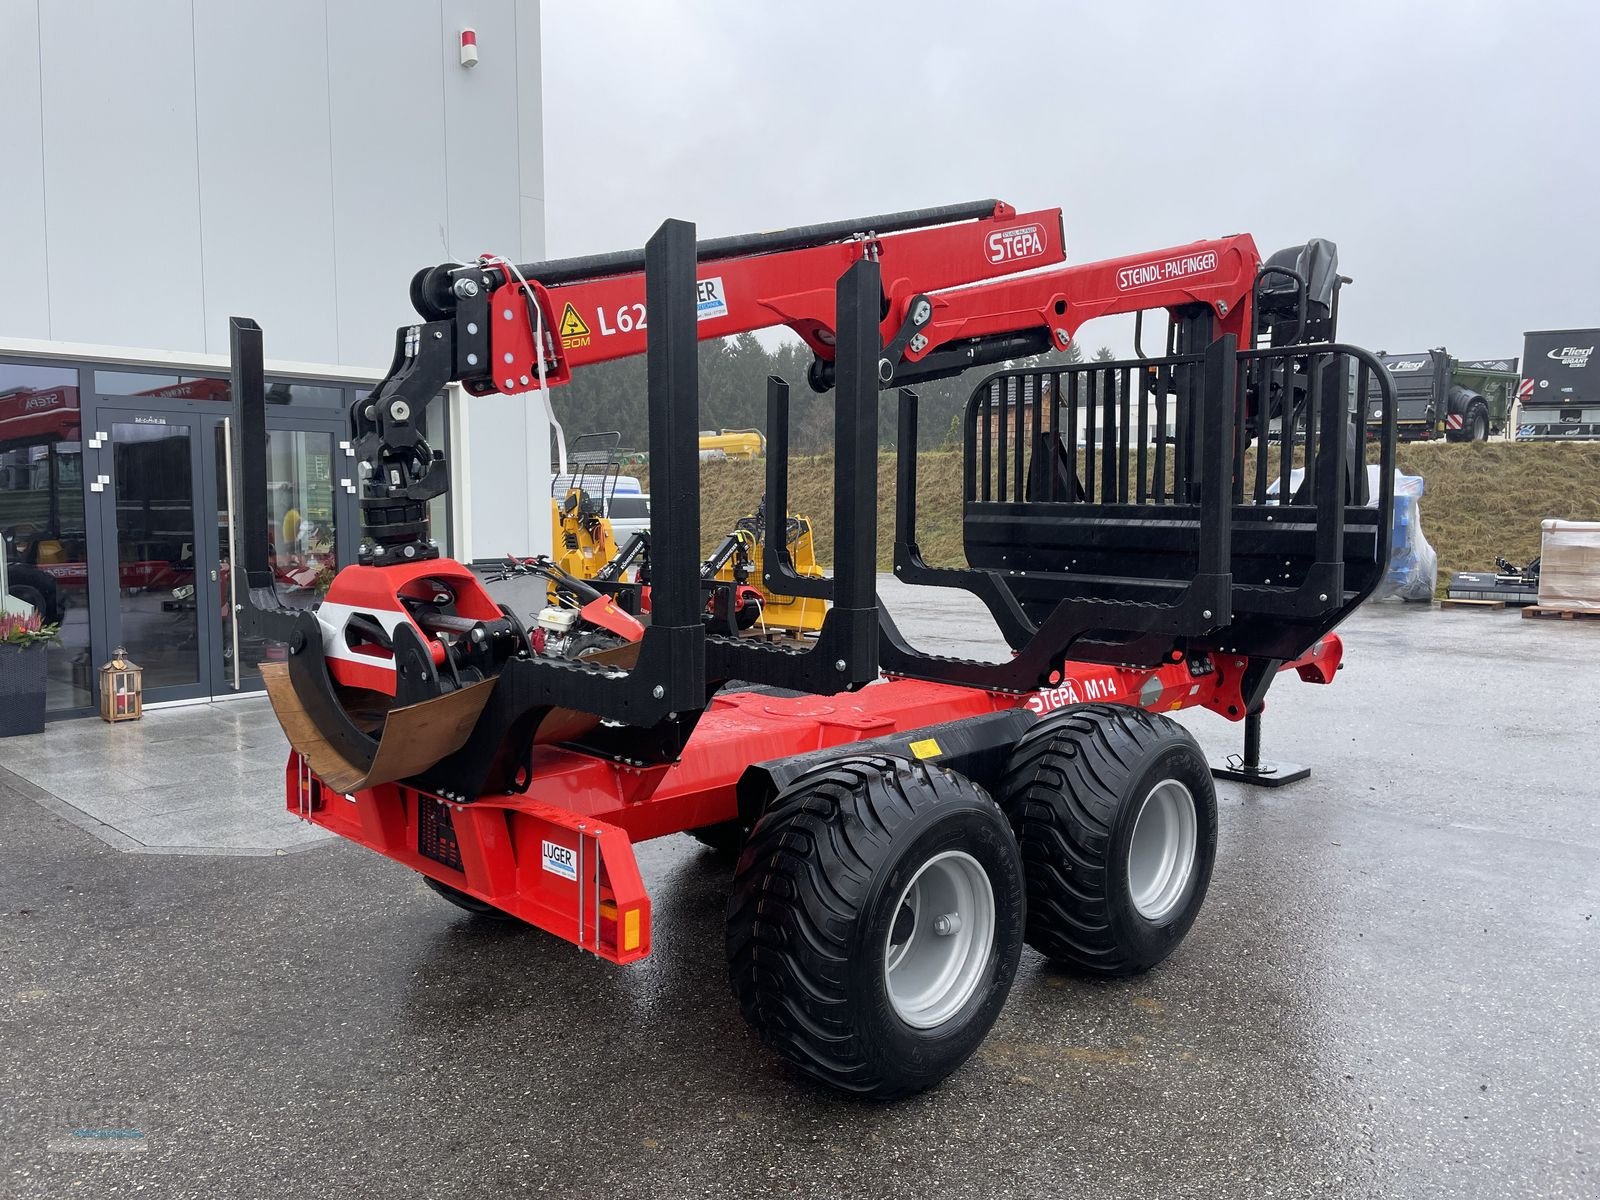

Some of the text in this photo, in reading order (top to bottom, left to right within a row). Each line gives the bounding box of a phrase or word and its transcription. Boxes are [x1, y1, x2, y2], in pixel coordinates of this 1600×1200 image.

[989, 232, 1042, 262] STEPA
[1120, 253, 1215, 288] STEINDL-PALFINGER
[1396, 360, 1426, 369] Fliegl
[1561, 345, 1594, 357] Fliegl
[1028, 677, 1117, 713] STEPA M14
[543, 843, 572, 867] LUGER
